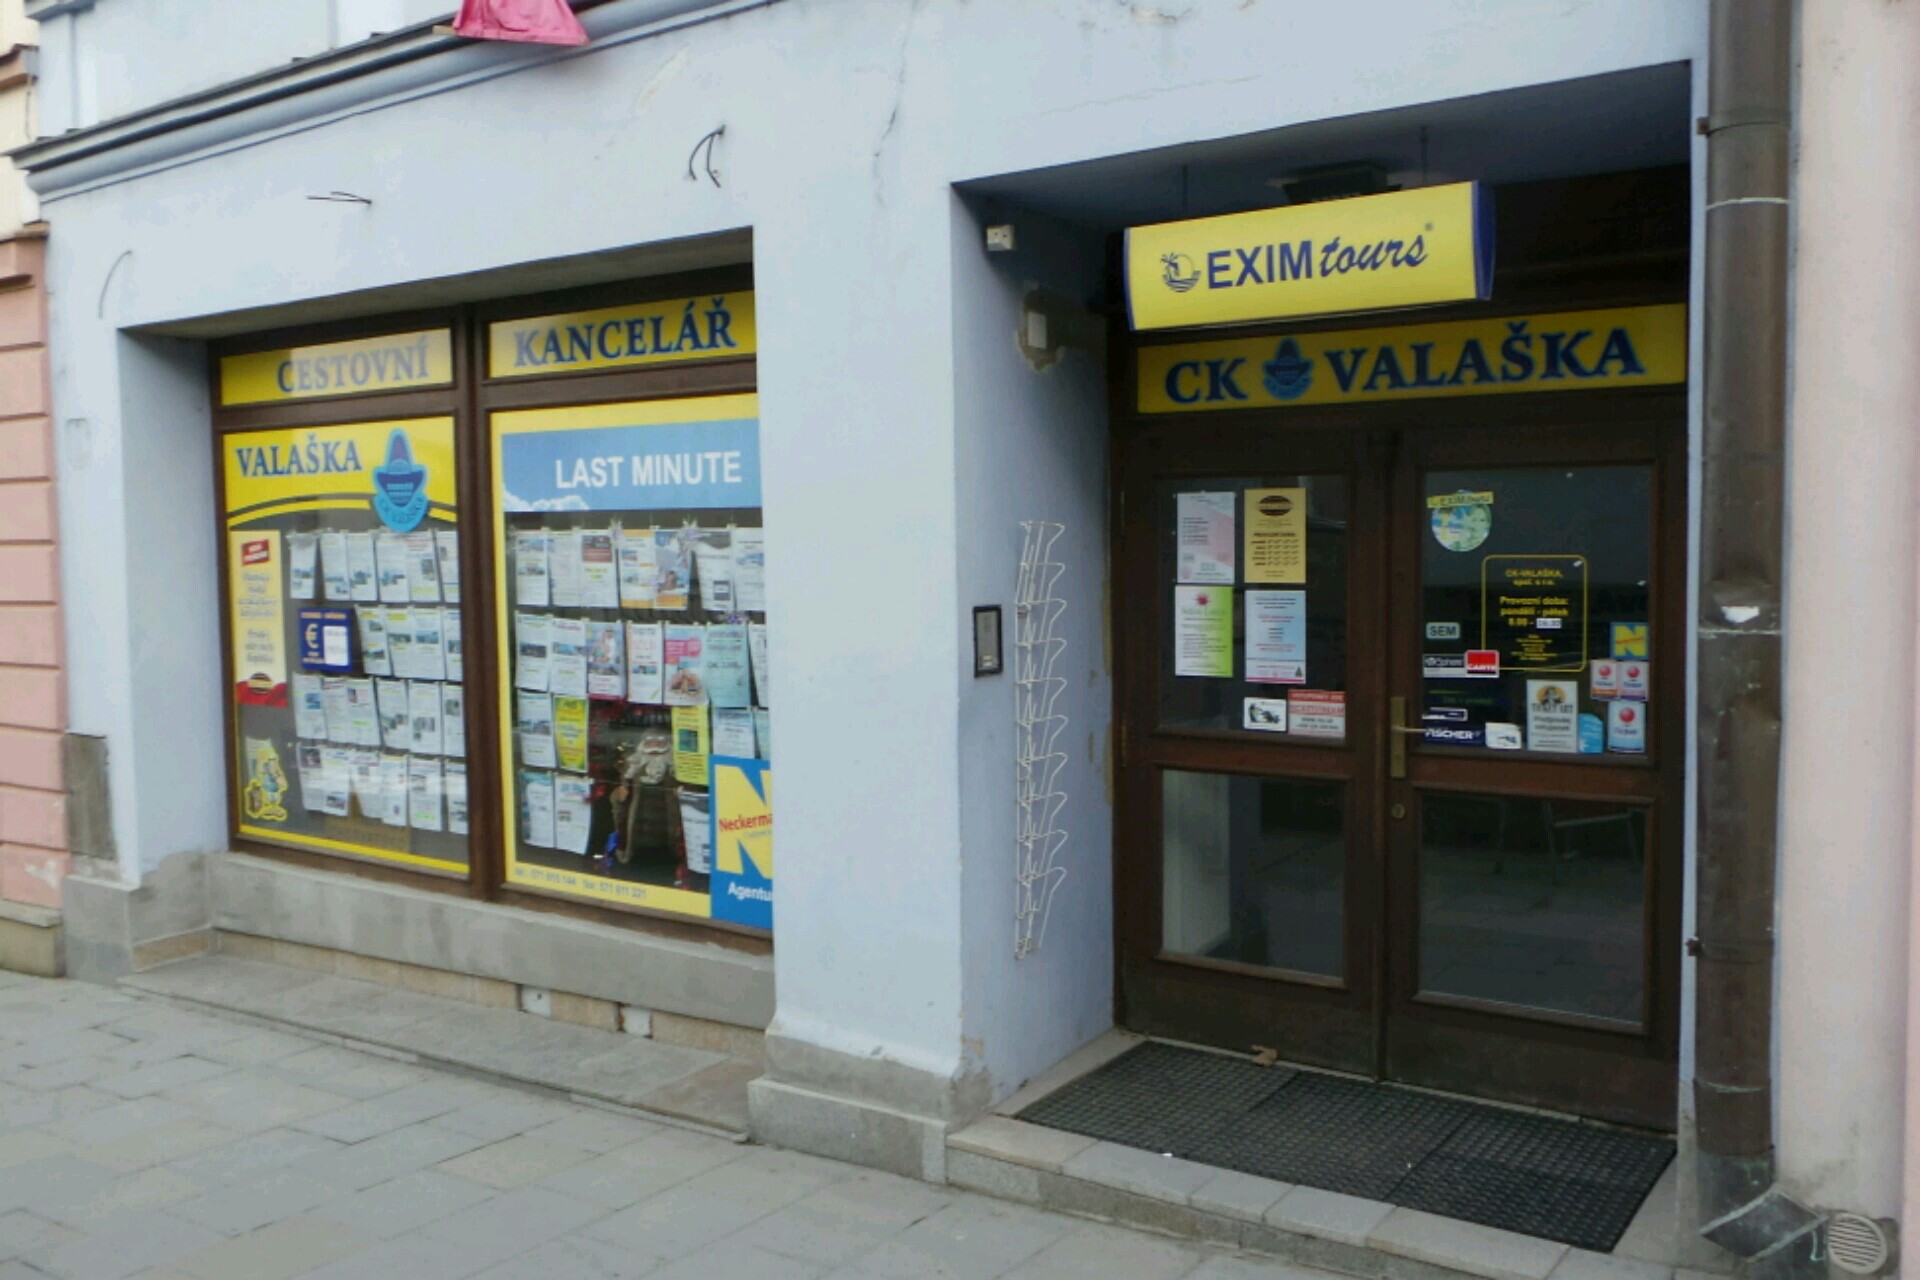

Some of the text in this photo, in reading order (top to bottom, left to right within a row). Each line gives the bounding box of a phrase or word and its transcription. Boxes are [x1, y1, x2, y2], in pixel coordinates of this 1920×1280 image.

[1207, 235, 1428, 289] EXIM tours
[513, 297, 737, 368] KANCELÁŘ
[276, 335, 429, 393] CESTOVNÍ
[1165, 321, 1646, 405] CK VALAŠKA
[236, 432, 363, 477] VALAŠKA
[555, 451, 743, 489] LAST MINUTE
[1499, 596, 1569, 606] Provozní doba:
[1500, 607, 1536, 617] pondělí
[1542, 608, 1569, 617] pátek
[1429, 625, 1458, 637] SEM
[1424, 728, 1474, 740] FISCHER
